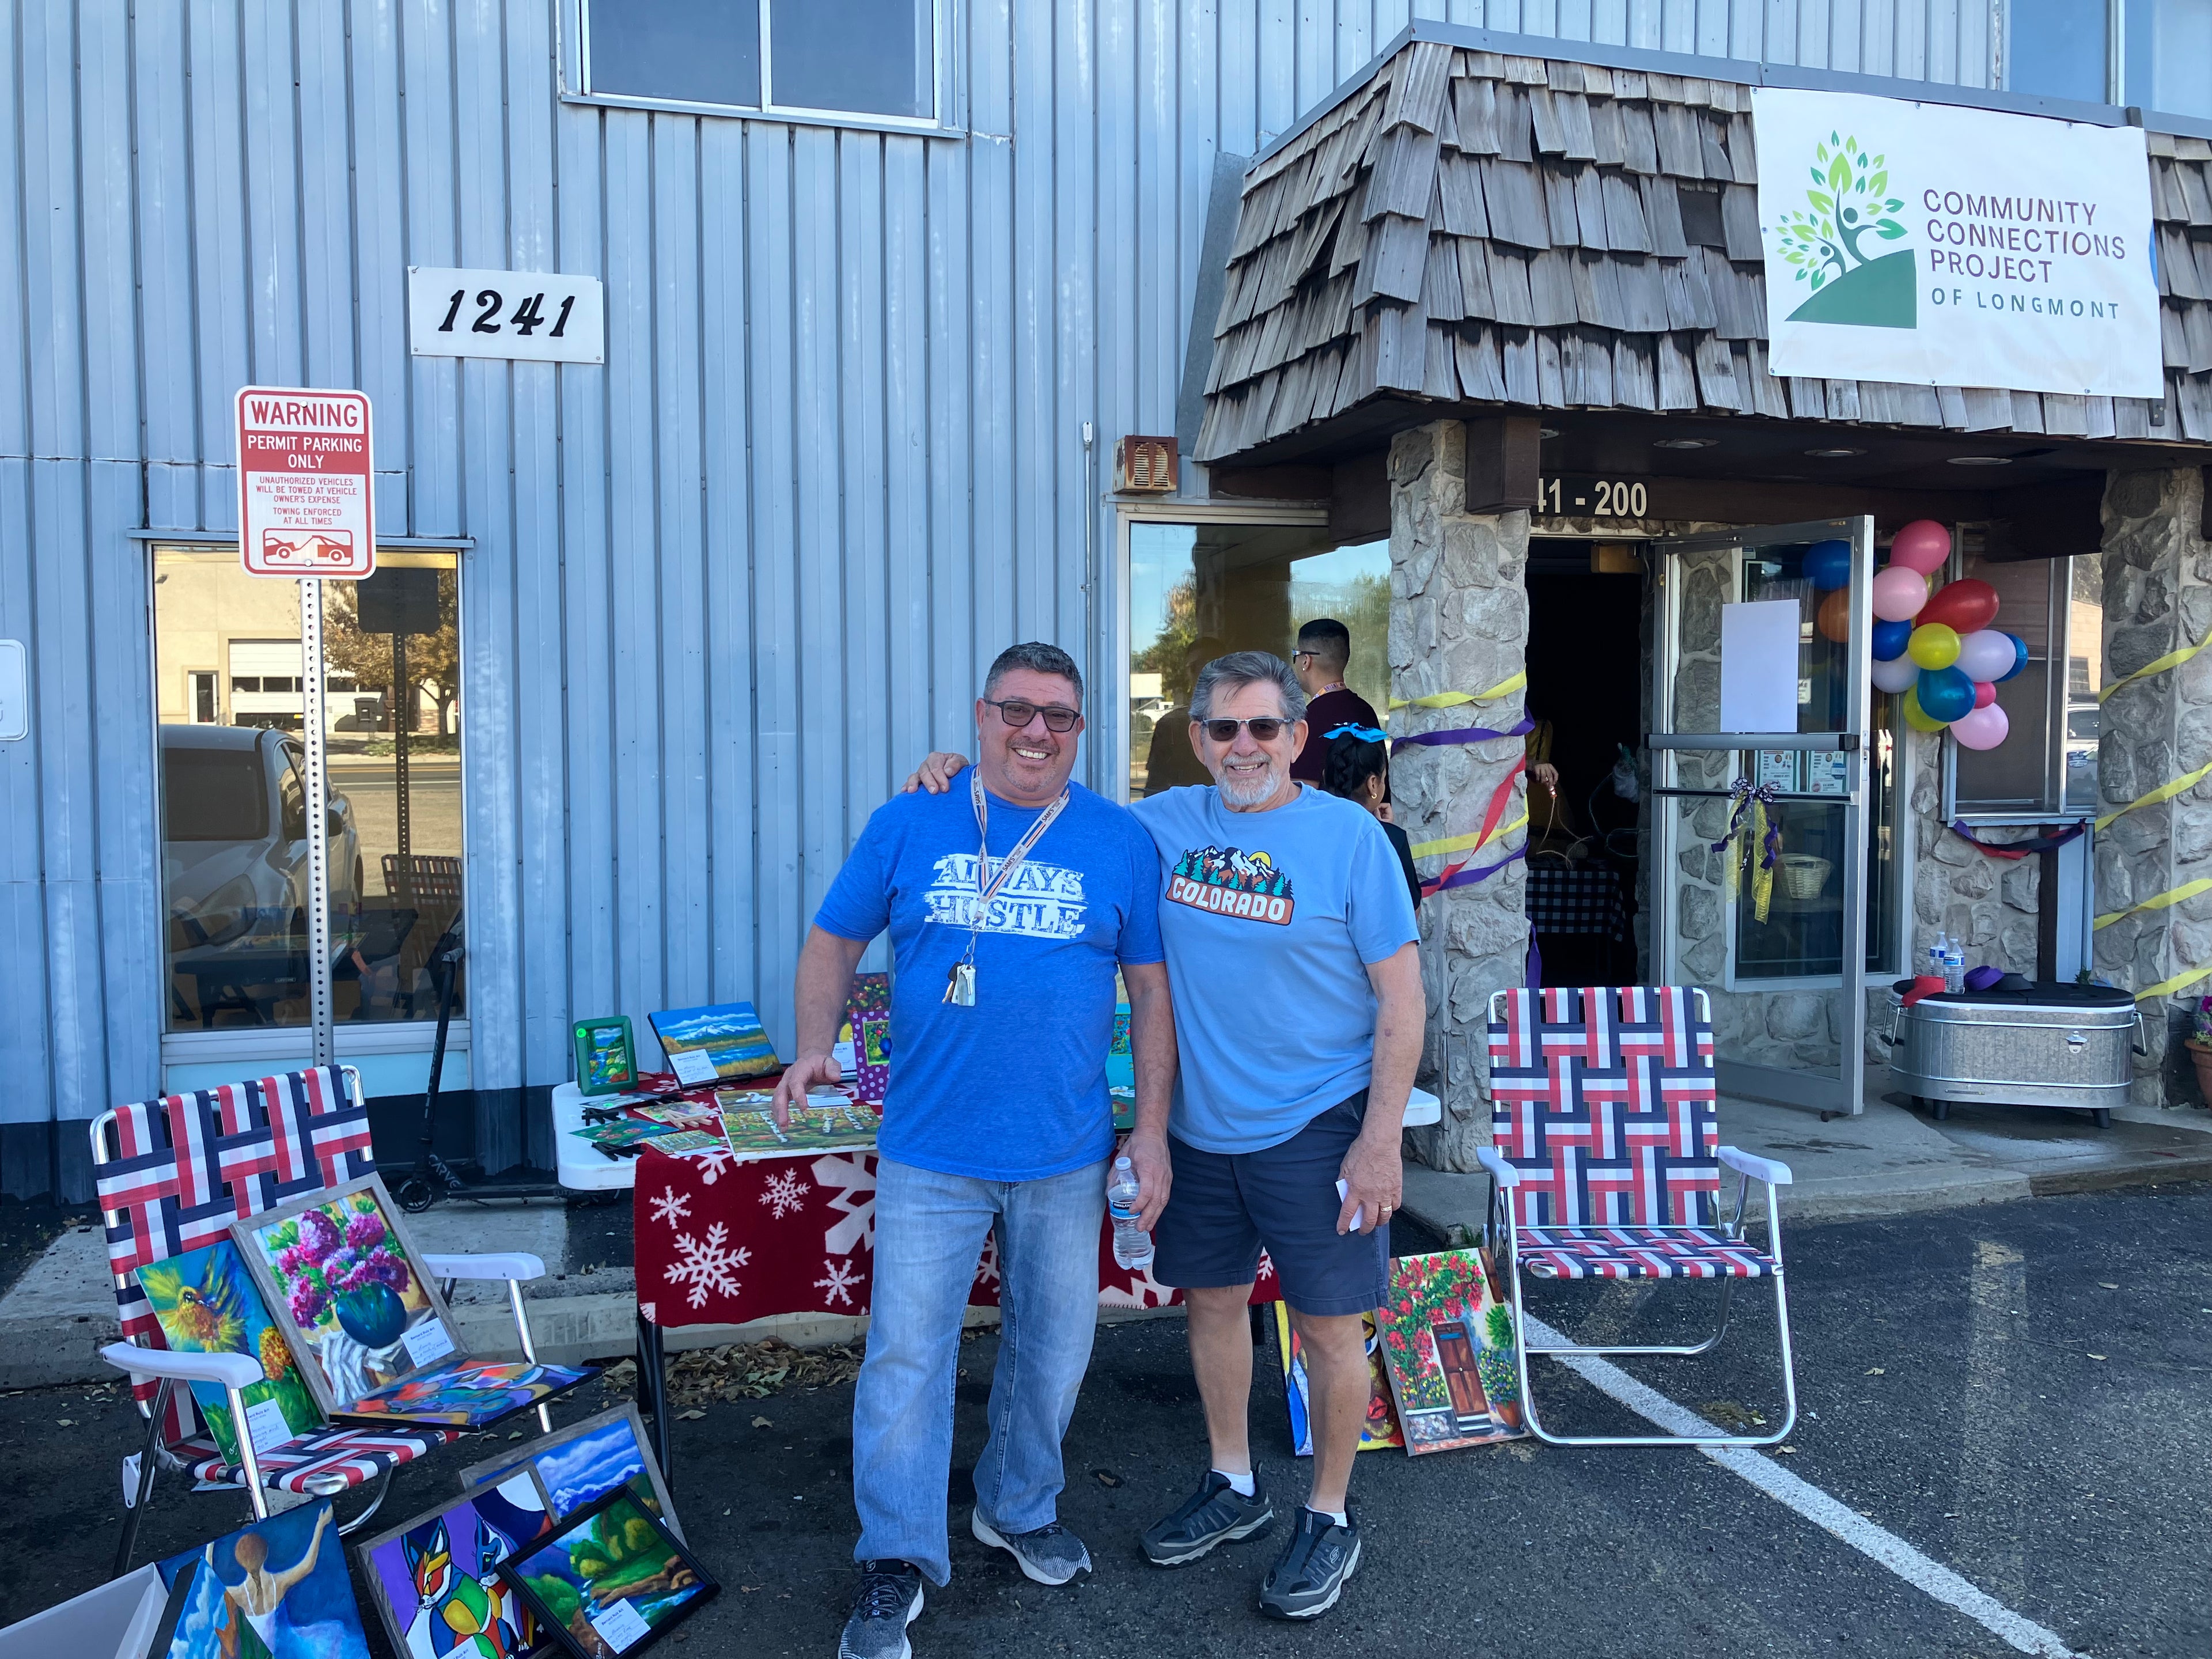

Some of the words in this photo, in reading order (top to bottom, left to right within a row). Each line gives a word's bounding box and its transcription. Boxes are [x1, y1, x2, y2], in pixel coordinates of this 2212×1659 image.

[1923, 188, 2097, 226] COMMUNITY
[1927, 218, 2126, 260] CONNECTIONS
[1931, 249, 2052, 283] PROJECT
[438, 289, 575, 338] 1241
[1931, 287, 1963, 306] OF
[1978, 291, 2120, 320] LONGMONT
[251, 400, 358, 428] WARNING
[247, 434, 298, 451] PERMIT
[303, 438, 362, 453] PARKING
[287, 454, 324, 469] ONLY
[256, 485, 272, 494] WILL
[288, 487, 313, 495] TOWED
[327, 487, 357, 496] VEHICLE
[259, 476, 316, 486] UNAUTHORIZED
[319, 478, 354, 486] VEHICLES
[272, 507, 301, 516] TOWING
[303, 507, 342, 517] ENFORCED
[274, 495, 305, 503] OWNER'S
[308, 497, 341, 505] EXPENSE
[1594, 480, 1647, 517] 200
[283, 517, 292, 525] AT
[295, 517, 309, 525] ALL
[312, 517, 332, 525] TIMES
[1173, 877, 1286, 921] COLORADO
[429, 1154, 461, 1189] CARVE
